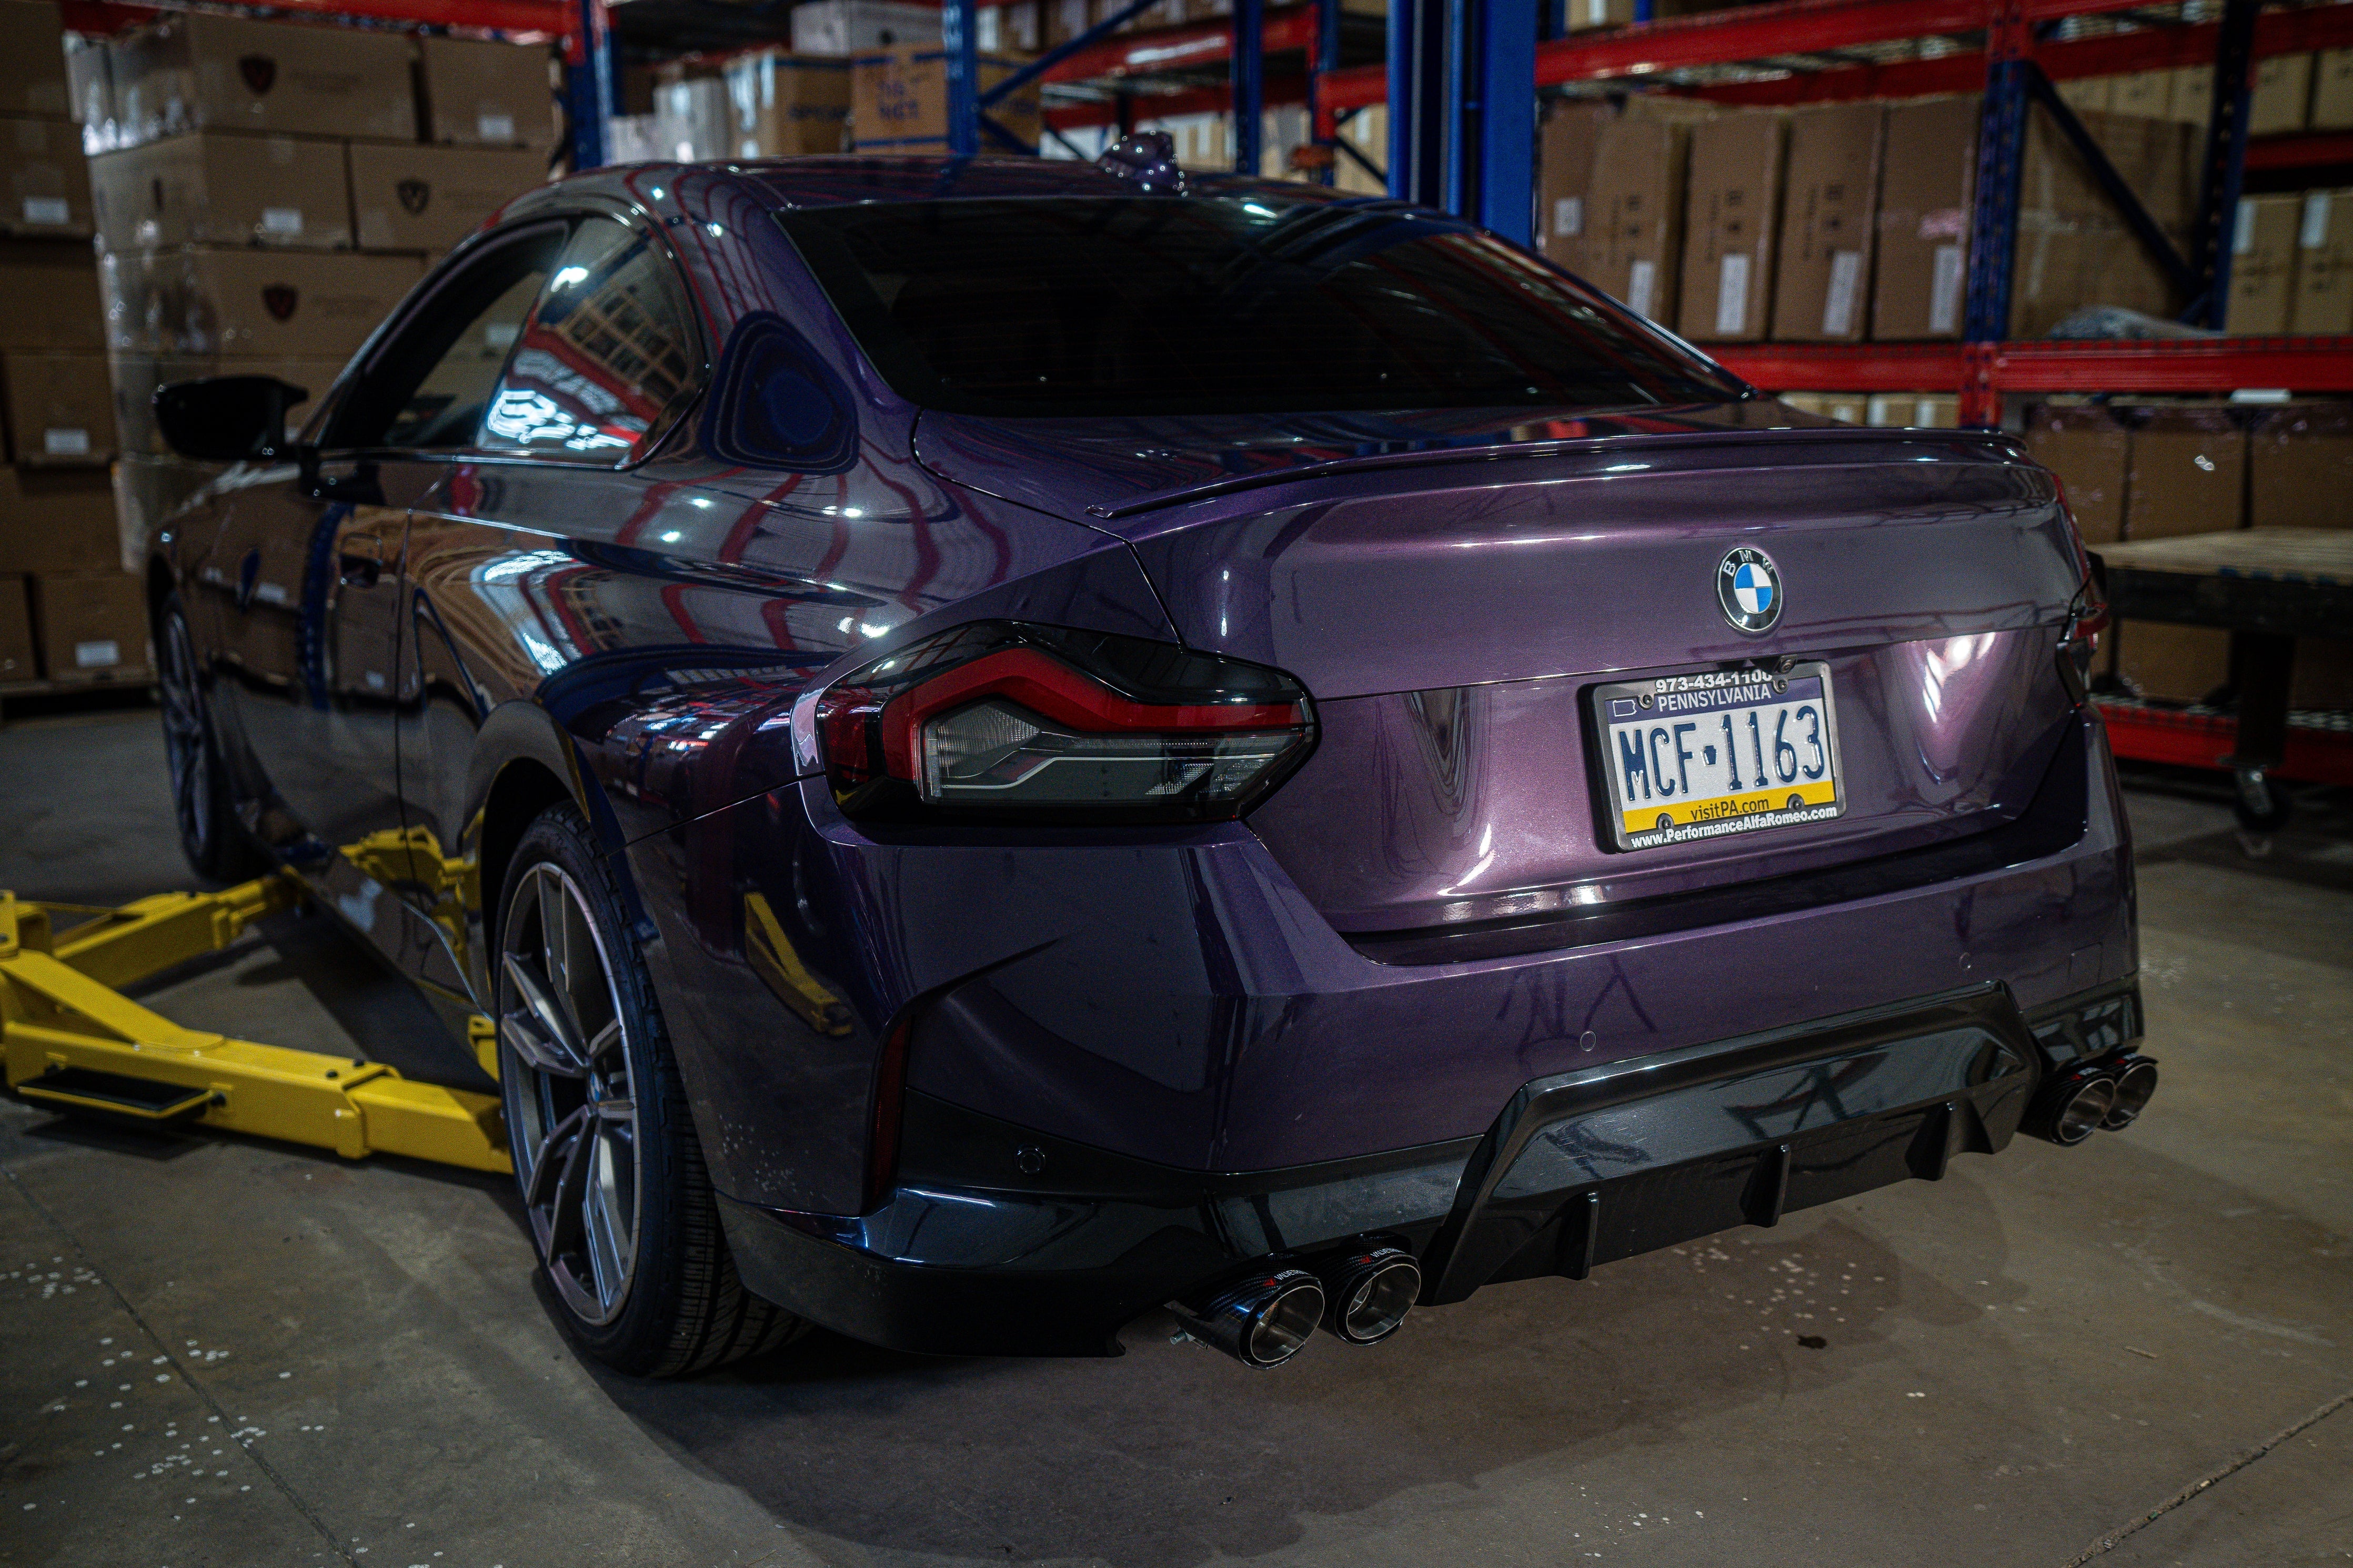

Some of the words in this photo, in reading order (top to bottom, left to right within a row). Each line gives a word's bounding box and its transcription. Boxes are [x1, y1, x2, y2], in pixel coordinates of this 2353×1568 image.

[1722, 549, 1774, 577] BMW
[1657, 683, 1772, 712] PENNSYLVANIA
[1690, 797, 1769, 821] visitPA.com
[1631, 806, 1837, 848] www.PerformanceAlfaRomeo.com
